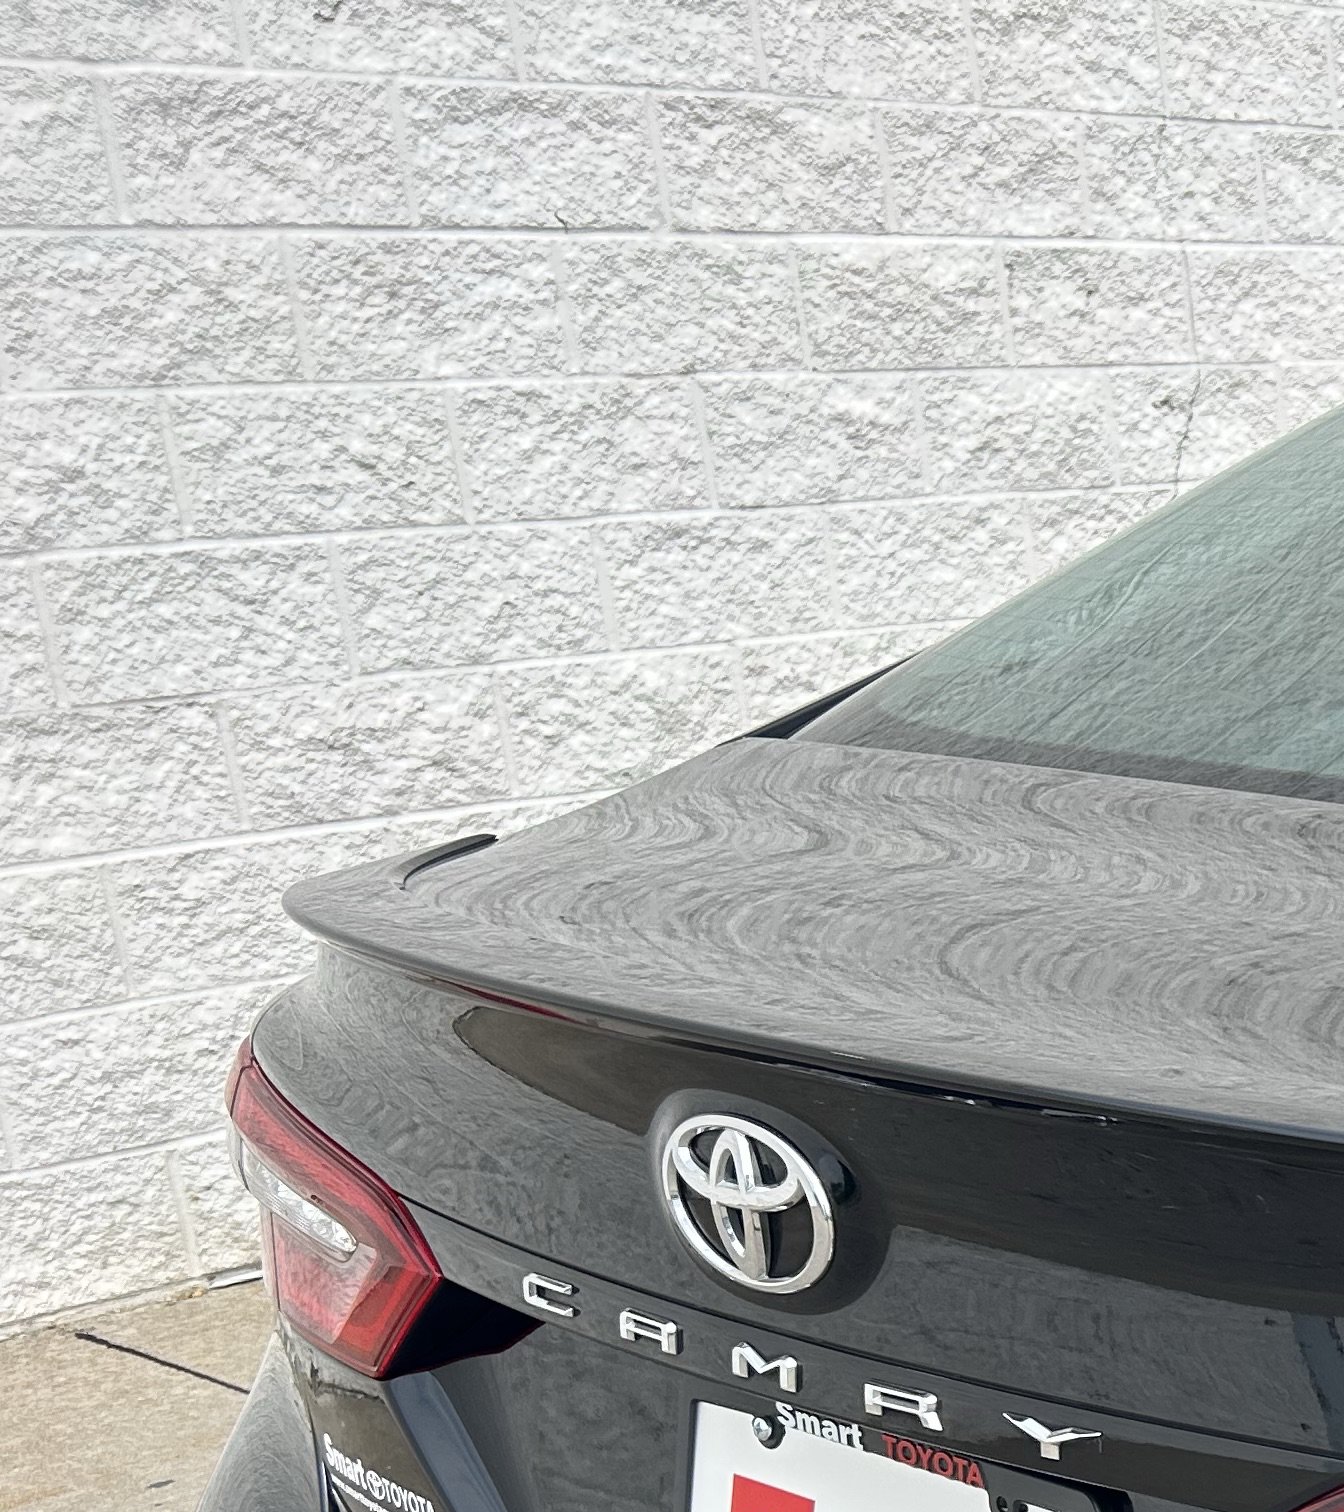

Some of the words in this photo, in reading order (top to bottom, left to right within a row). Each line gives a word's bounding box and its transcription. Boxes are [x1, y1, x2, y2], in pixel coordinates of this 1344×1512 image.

[522, 1273, 1102, 1460] CAMRY
[323, 1433, 368, 1490] Smart
[775, 1401, 864, 1451] Smart
[881, 1433, 985, 1488] TOYOTA
